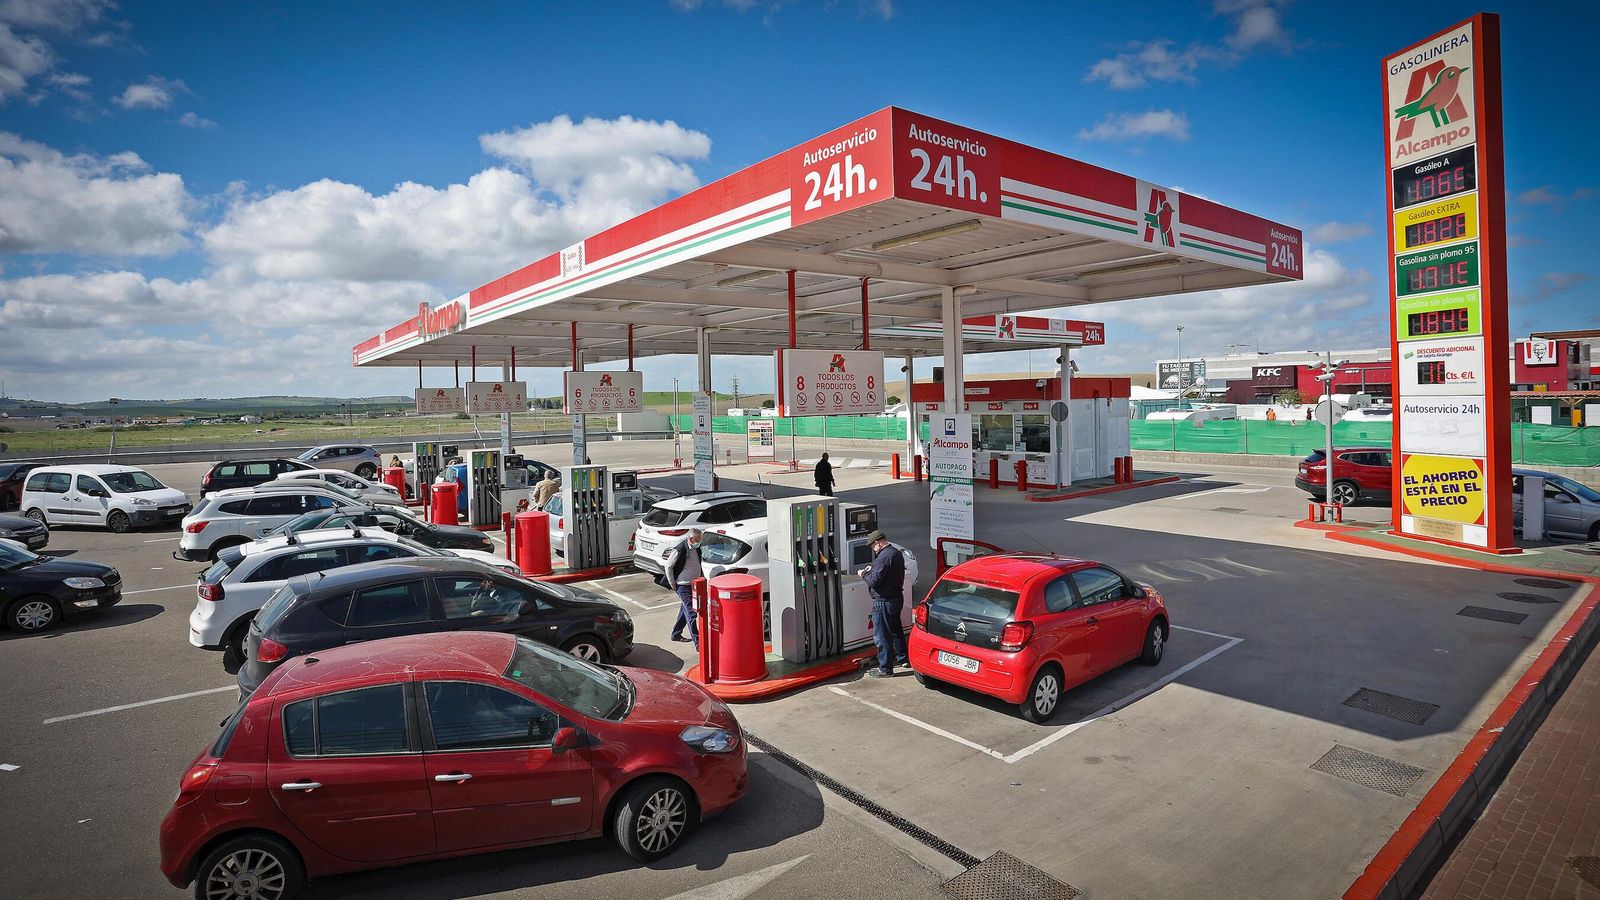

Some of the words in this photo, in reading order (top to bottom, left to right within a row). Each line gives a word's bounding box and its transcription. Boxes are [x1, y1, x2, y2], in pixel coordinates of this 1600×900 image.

[1390, 34, 1469, 76] GASOLINERA
[908, 122, 987, 158] Autoservicio
[1395, 126, 1471, 160] Alcampo
[803, 128, 877, 168] Autoservicio
[1415, 160, 1442, 175] Gasóleo
[1443, 157, 1450, 166] A
[804, 154, 878, 212] 24h.
[910, 147, 988, 204] 24h.
[1408, 208, 1435, 220] Gasóleo
[1437, 202, 1461, 214] EXTRA
[1270, 228, 1298, 244] Autoservicio
[1271, 242, 1298, 272] 24h.
[1399, 255, 1427, 266] Gasolina
[1428, 253, 1439, 261] sin
[1440, 249, 1463, 260] plomo
[1464, 245, 1475, 255] 95
[1401, 301, 1429, 310] Gasolina
[1430, 298, 1440, 306] sin
[1441, 296, 1465, 307] plomo
[1085, 329, 1102, 341] 24h.
[1416, 347, 1446, 355] DESCUENTO
[1256, 368, 1282, 377] KFC
[1446, 372, 1460, 380] Cts.
[1460, 371, 1475, 380] €/L
[796, 375, 805, 391] 8
[816, 382, 857, 390] PRODUCTOS
[867, 375, 875, 390] 8
[575, 388, 582, 398] 6
[628, 388, 635, 397] 6
[1403, 404, 1459, 414] Autoservicio
[1461, 404, 1480, 414] 24h
[933, 438, 969, 450] Alcampo
[935, 462, 967, 471] AUTOPAGO
[1404, 476, 1419, 485] EL
[1422, 470, 1478, 483] AHORRO
[1405, 483, 1438, 496] ESTÁ
[1441, 483, 1460, 494] EN
[1463, 482, 1482, 492] EL
[1420, 495, 1468, 507] PRECIO
[944, 653, 960, 665] 0056
[964, 659, 977, 670] JBR
